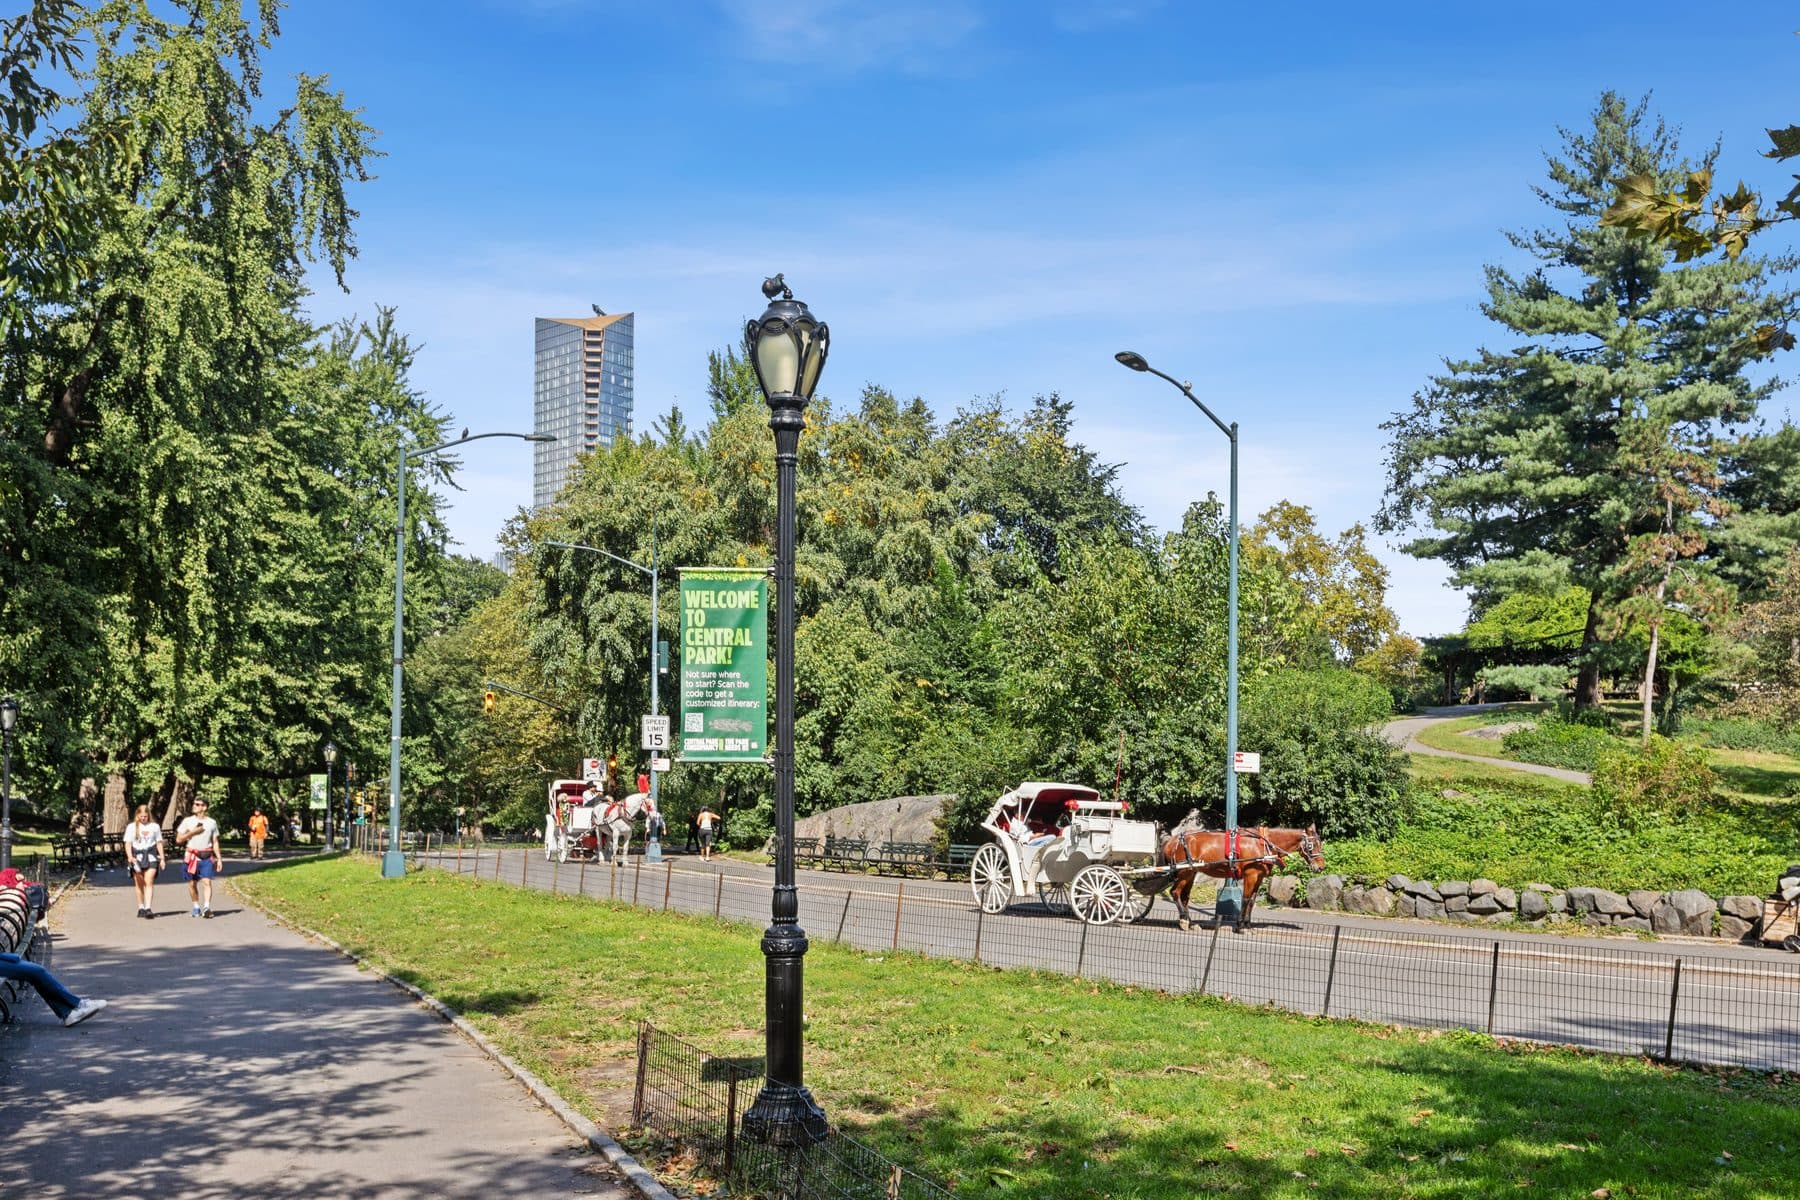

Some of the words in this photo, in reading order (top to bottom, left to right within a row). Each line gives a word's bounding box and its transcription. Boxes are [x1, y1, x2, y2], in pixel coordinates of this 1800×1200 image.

[685, 590, 759, 608] WELCOME
[685, 608, 706, 627] TO
[686, 628, 752, 646] CENTRAL
[686, 646, 732, 664] PARK!
[714, 690, 726, 698] get
[649, 734, 663, 746] 15
